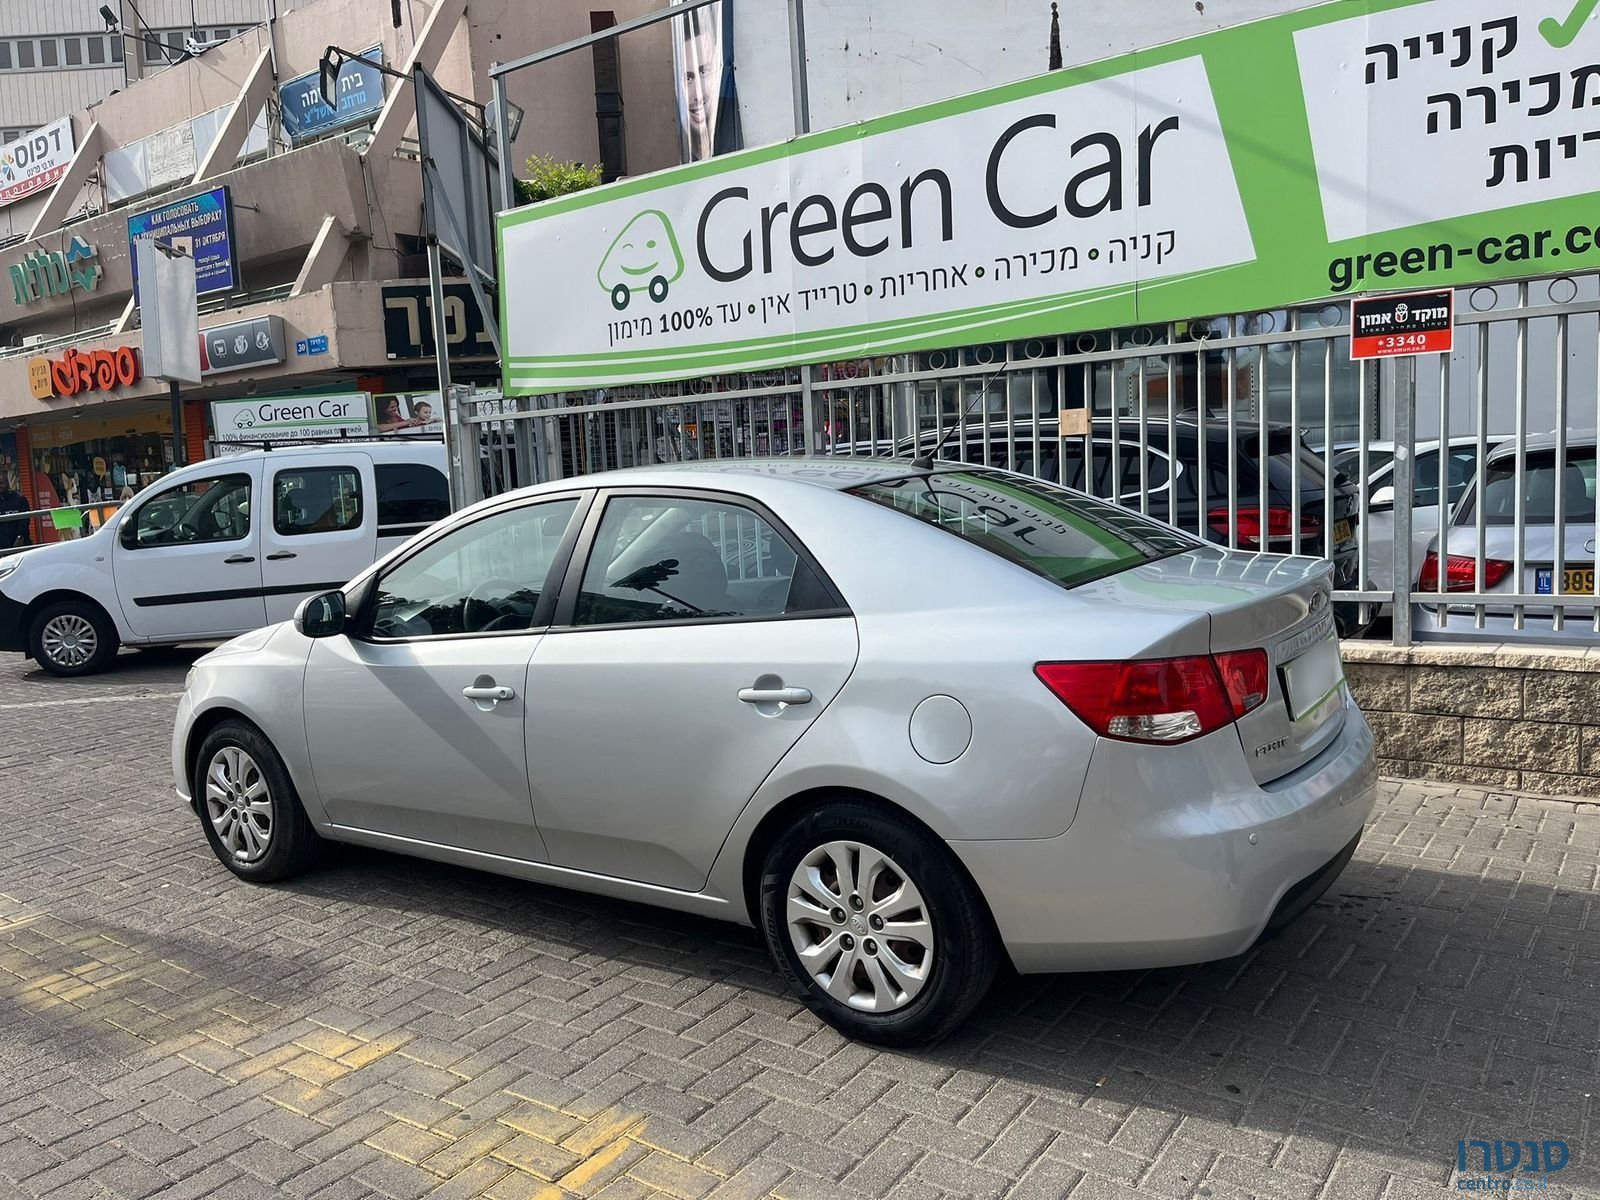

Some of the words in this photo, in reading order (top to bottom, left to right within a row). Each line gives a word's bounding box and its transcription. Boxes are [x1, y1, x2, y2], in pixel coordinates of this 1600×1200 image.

[1365, 15, 1518, 85] קנייה
[341, 72, 364, 92] בית
[14, 127, 61, 169] דפוס
[696, 168, 953, 283] Green
[985, 113, 1179, 229] Car
[151, 212, 162, 226] КАК
[162, 201, 199, 221] ГОЛОСОВАТЬ
[191, 209, 222, 229] ВЫБОРАХ?
[195, 237, 201, 249] 31
[202, 231, 226, 247] ОКТЯБРЯ
[1108, 230, 1175, 265] קניה
[994, 246, 1078, 281] מכירה
[1328, 225, 1600, 293] green-car.c
[879, 263, 968, 299] אחריות
[760, 293, 791, 324] אין
[797, 282, 857, 311] טרייד
[659, 307, 713, 333] 100%
[716, 301, 741, 324] עד
[1359, 312, 1392, 329] אמון
[1411, 306, 1448, 323] מוקד
[607, 317, 653, 347] מימון
[297, 343, 306, 353] 30
[258, 404, 315, 422] Green
[318, 400, 350, 418] Car
[290, 430, 298, 439] до
[299, 428, 310, 437] 100
